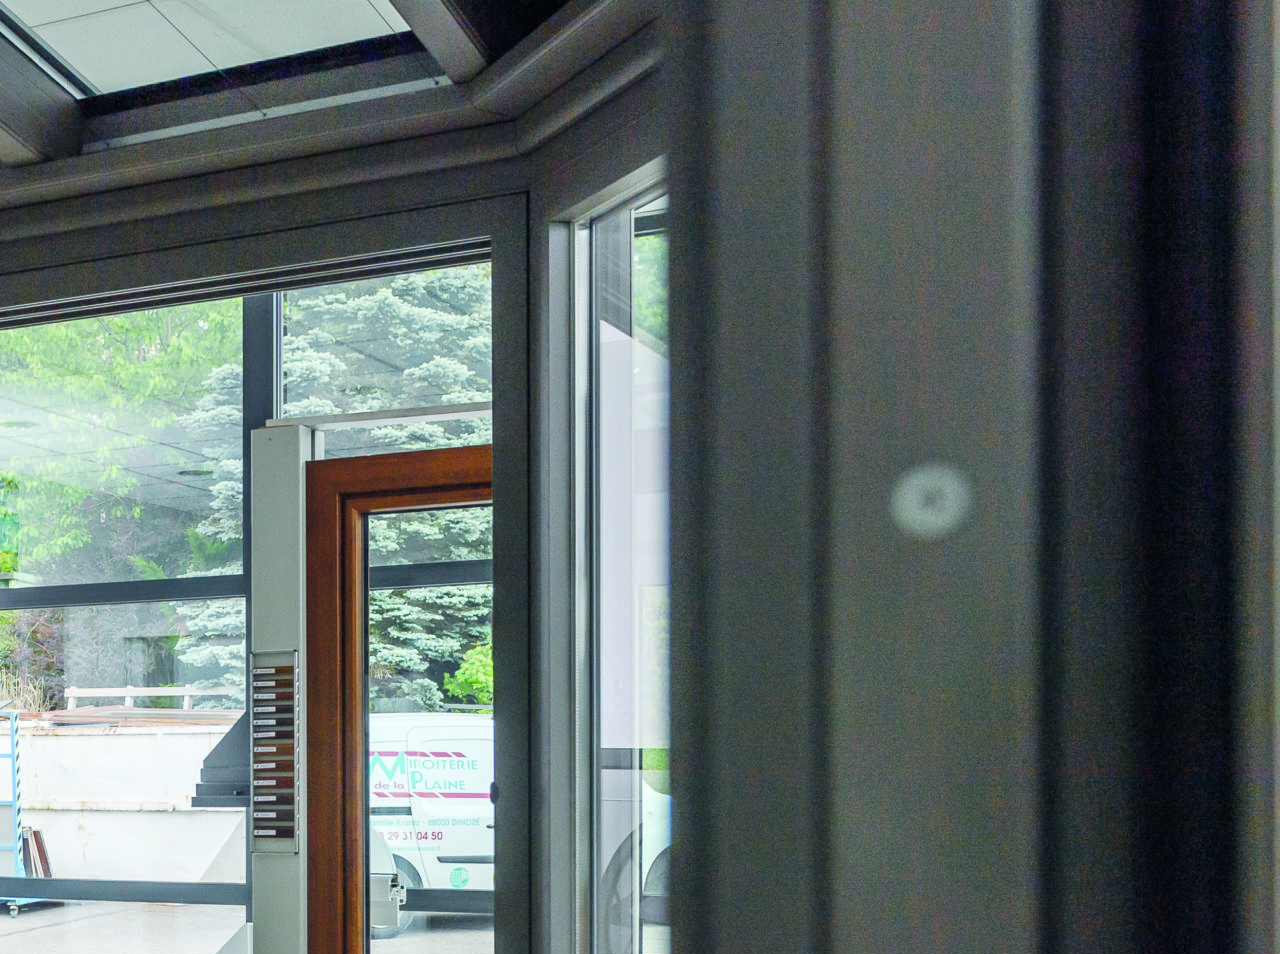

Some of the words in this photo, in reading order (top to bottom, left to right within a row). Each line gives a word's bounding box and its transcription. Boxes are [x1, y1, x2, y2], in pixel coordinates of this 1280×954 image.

[374, 781, 390, 790] de
[394, 781, 405, 790] la
[410, 770, 465, 790] PLAINE
[369, 818, 394, 827] amille
[387, 831, 399, 841] 29
[402, 831, 413, 841] 31
[416, 831, 428, 841] 04
[431, 831, 443, 841] 50
